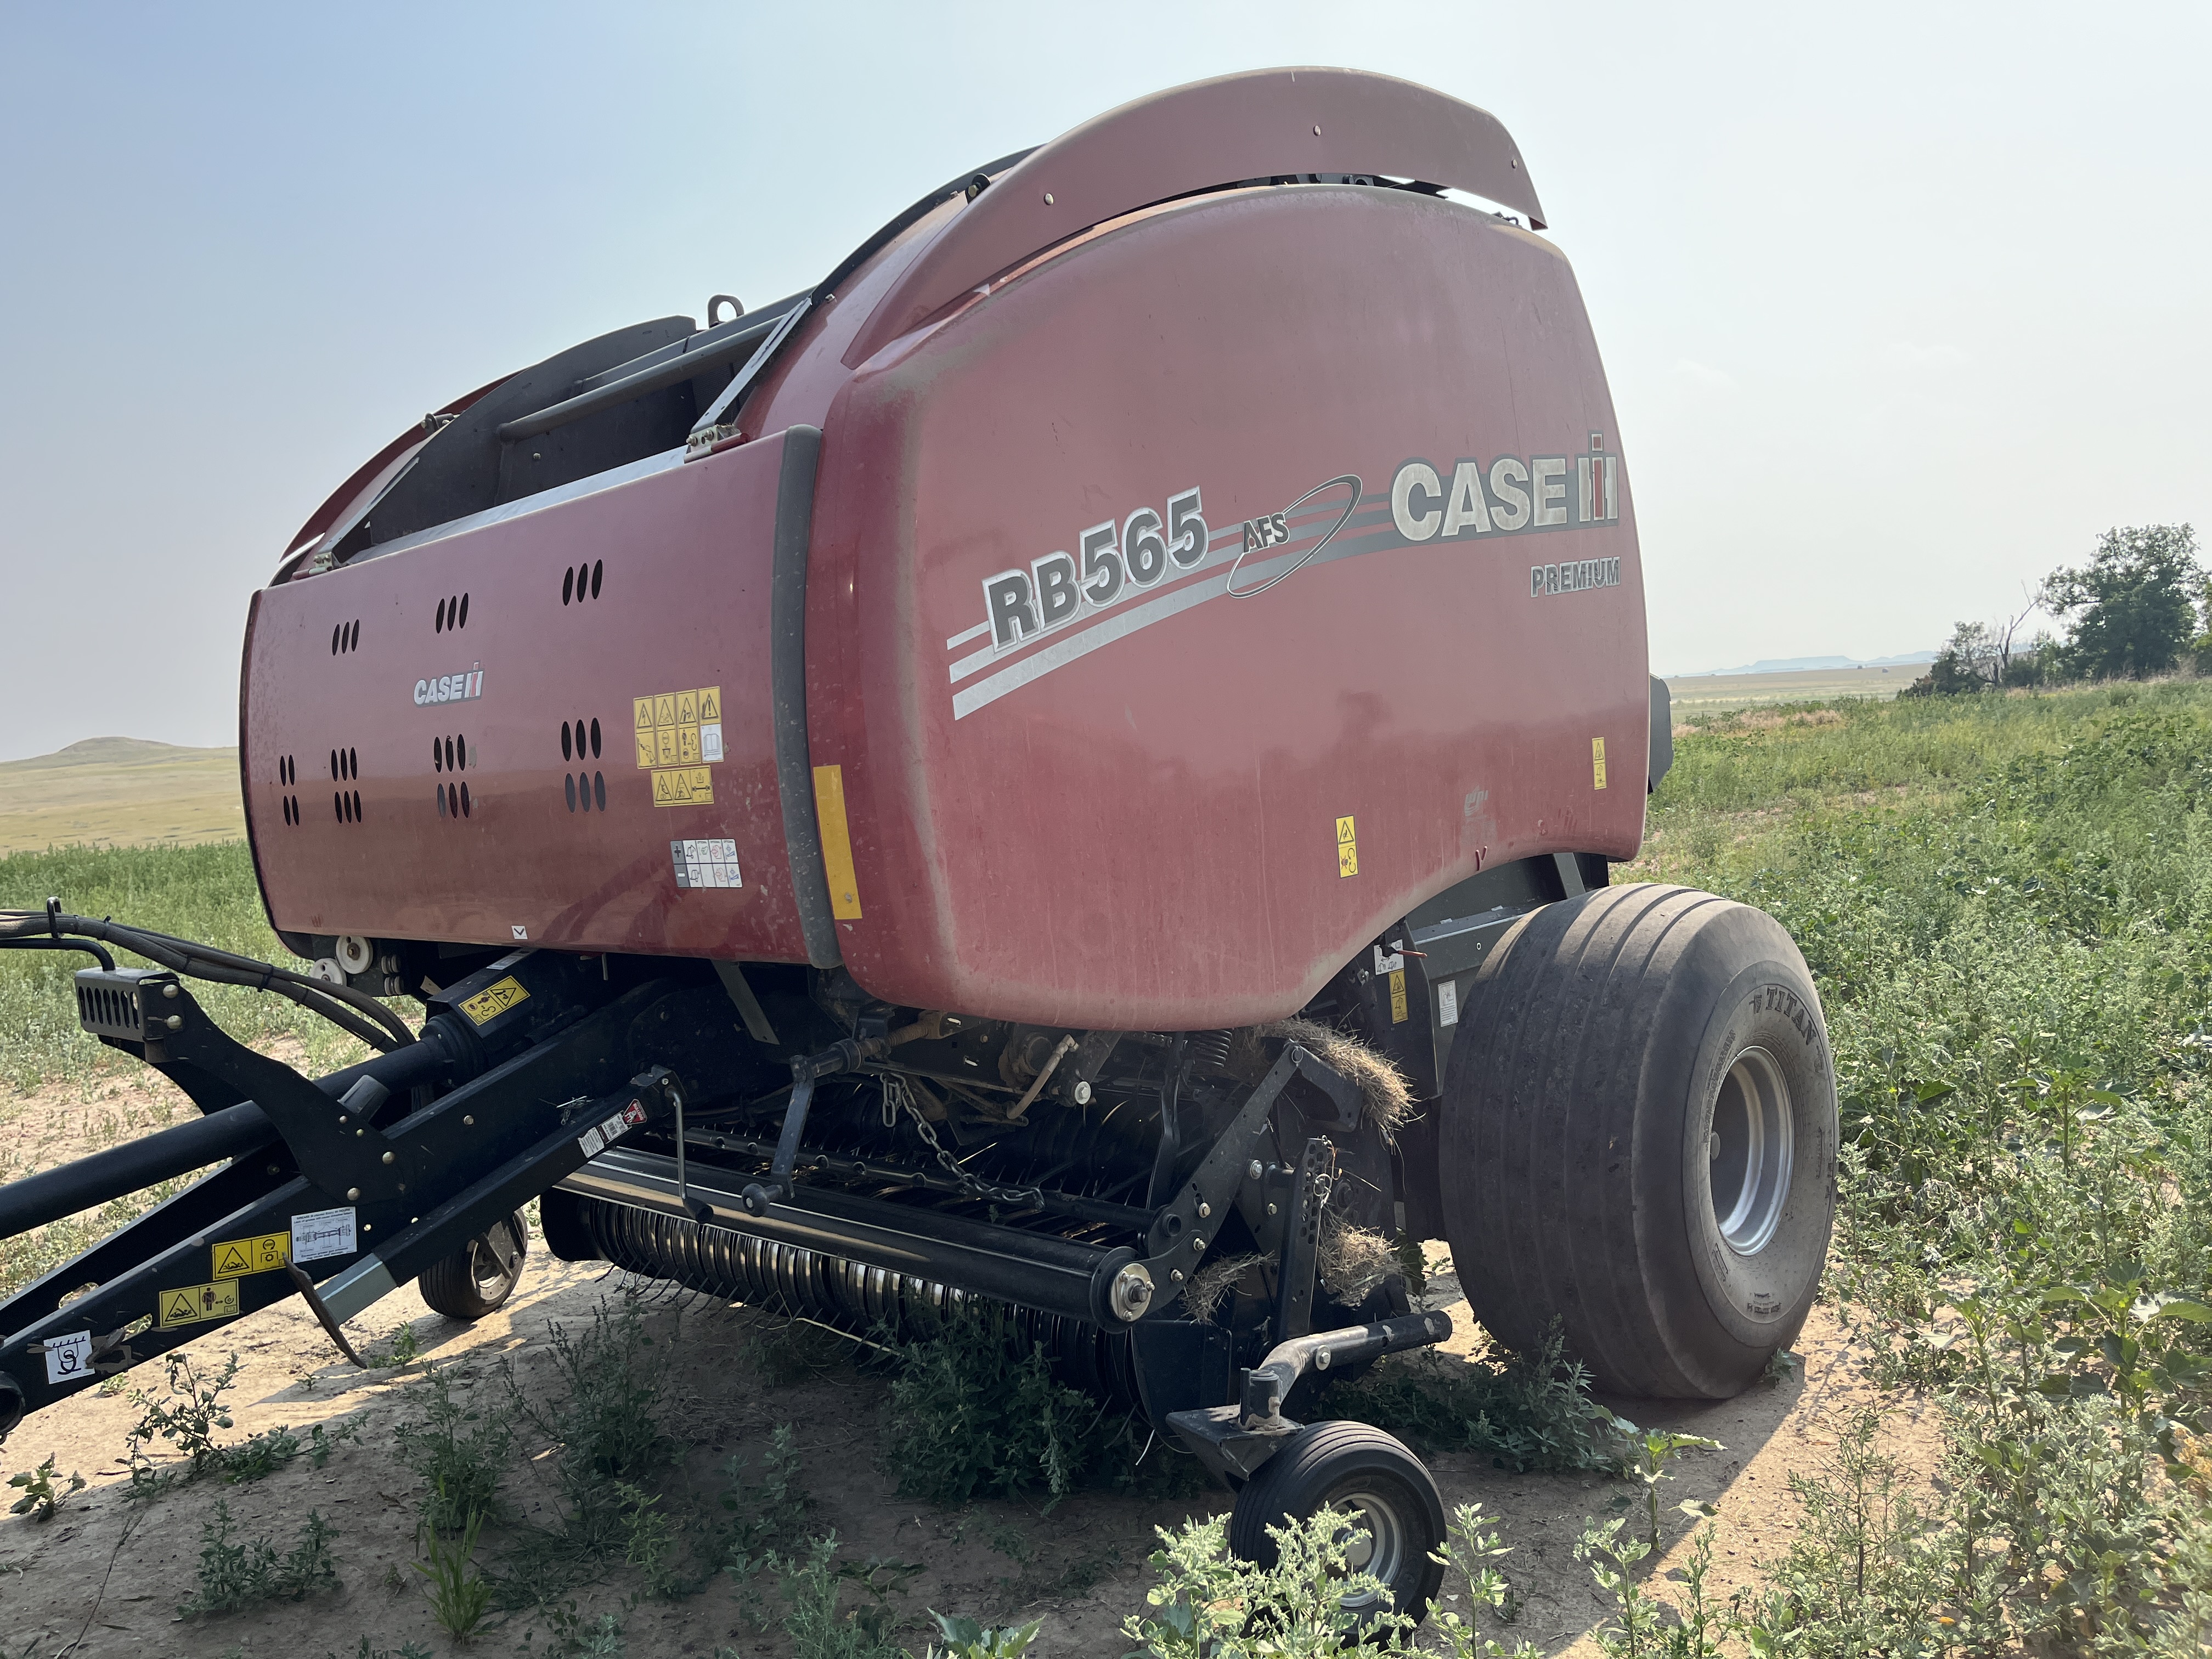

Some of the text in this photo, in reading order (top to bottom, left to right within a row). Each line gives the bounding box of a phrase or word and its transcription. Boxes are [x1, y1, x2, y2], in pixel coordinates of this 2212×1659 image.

[1391, 458, 1568, 541] CASE
[1243, 512, 1290, 554] AFS
[981, 485, 1209, 653] RB565
[1530, 556, 1621, 598] PREMIUM
[414, 674, 465, 705] CASE
[1765, 987, 1817, 1046] TITAN
[633, 1103, 644, 1121] BULLDOG
